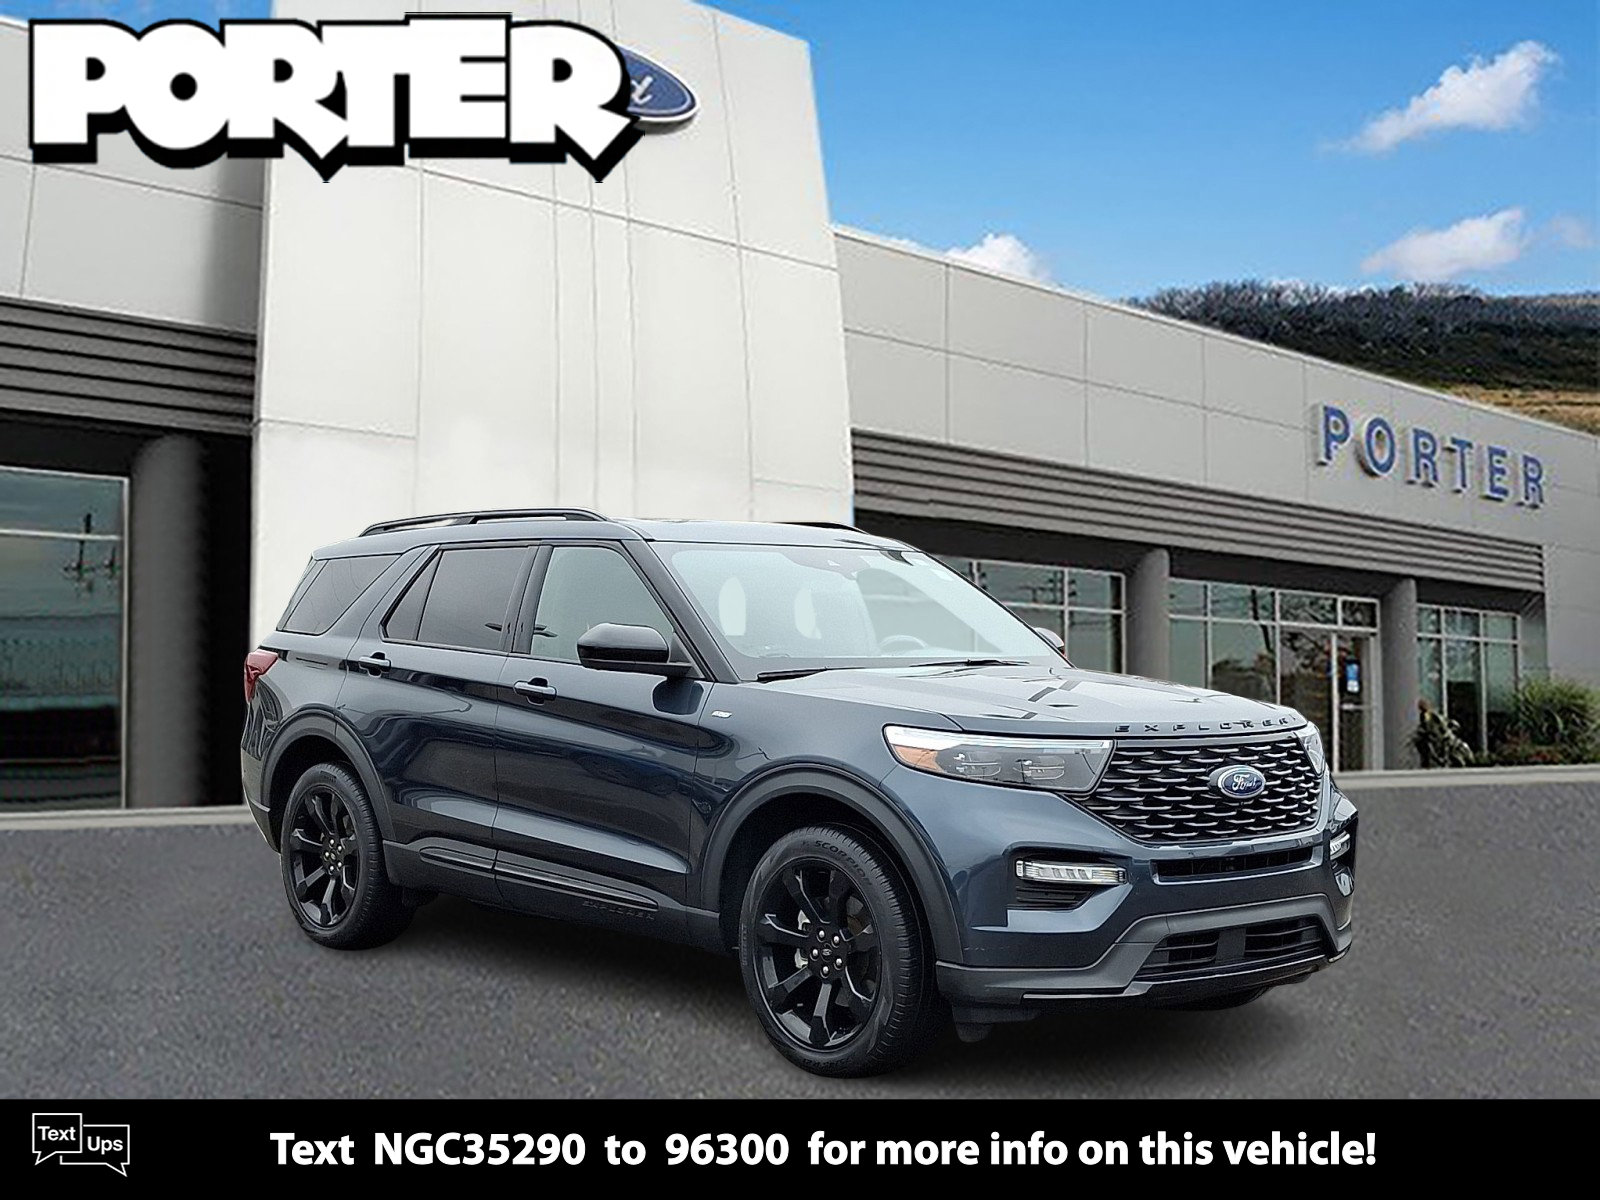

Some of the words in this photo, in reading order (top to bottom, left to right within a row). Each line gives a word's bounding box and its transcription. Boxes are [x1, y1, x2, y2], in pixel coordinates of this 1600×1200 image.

[1320, 405, 1544, 506] PORTER
[1115, 718, 1288, 733] EXPLORER
[1232, 773, 1262, 791] Ford
